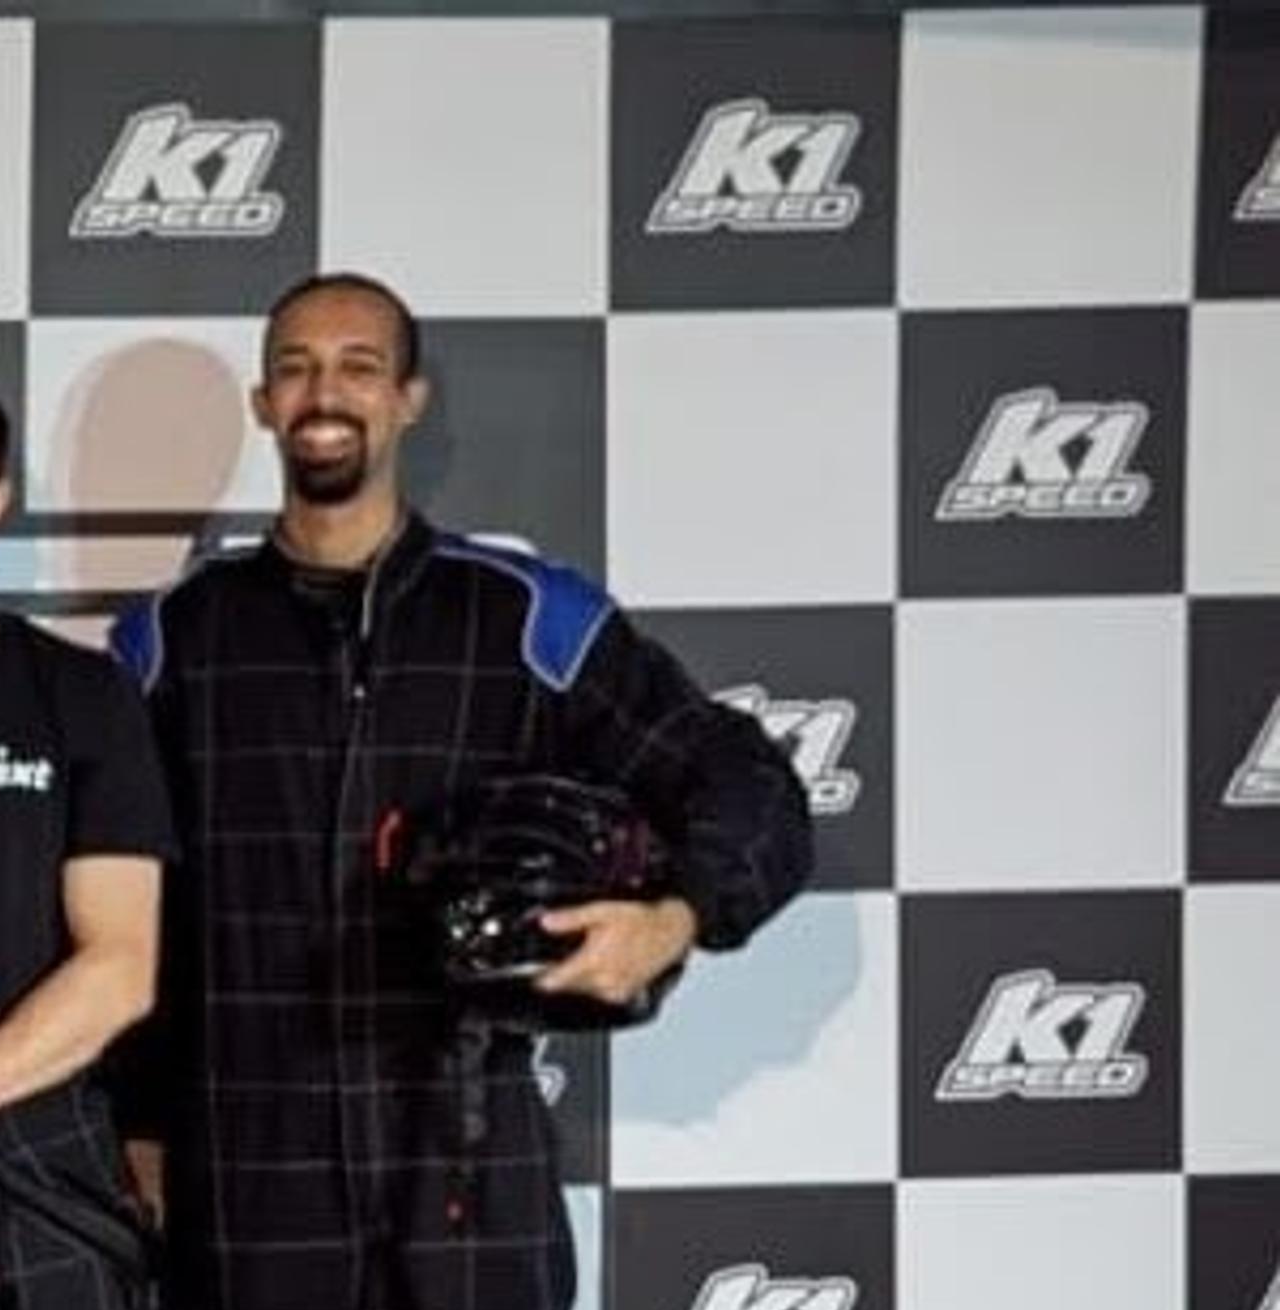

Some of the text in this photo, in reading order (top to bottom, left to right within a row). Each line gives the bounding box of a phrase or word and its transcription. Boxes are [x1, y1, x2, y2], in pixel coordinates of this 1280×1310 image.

[103, 114, 270, 199] K1
[679, 109, 847, 193] K1
[86, 202, 274, 226] SPEED
[666, 197, 853, 221] SPEED
[970, 402, 1137, 482] K1
[953, 485, 1138, 506] SPEED
[969, 979, 1133, 1059] K1
[951, 1062, 1135, 1086] SPEED
